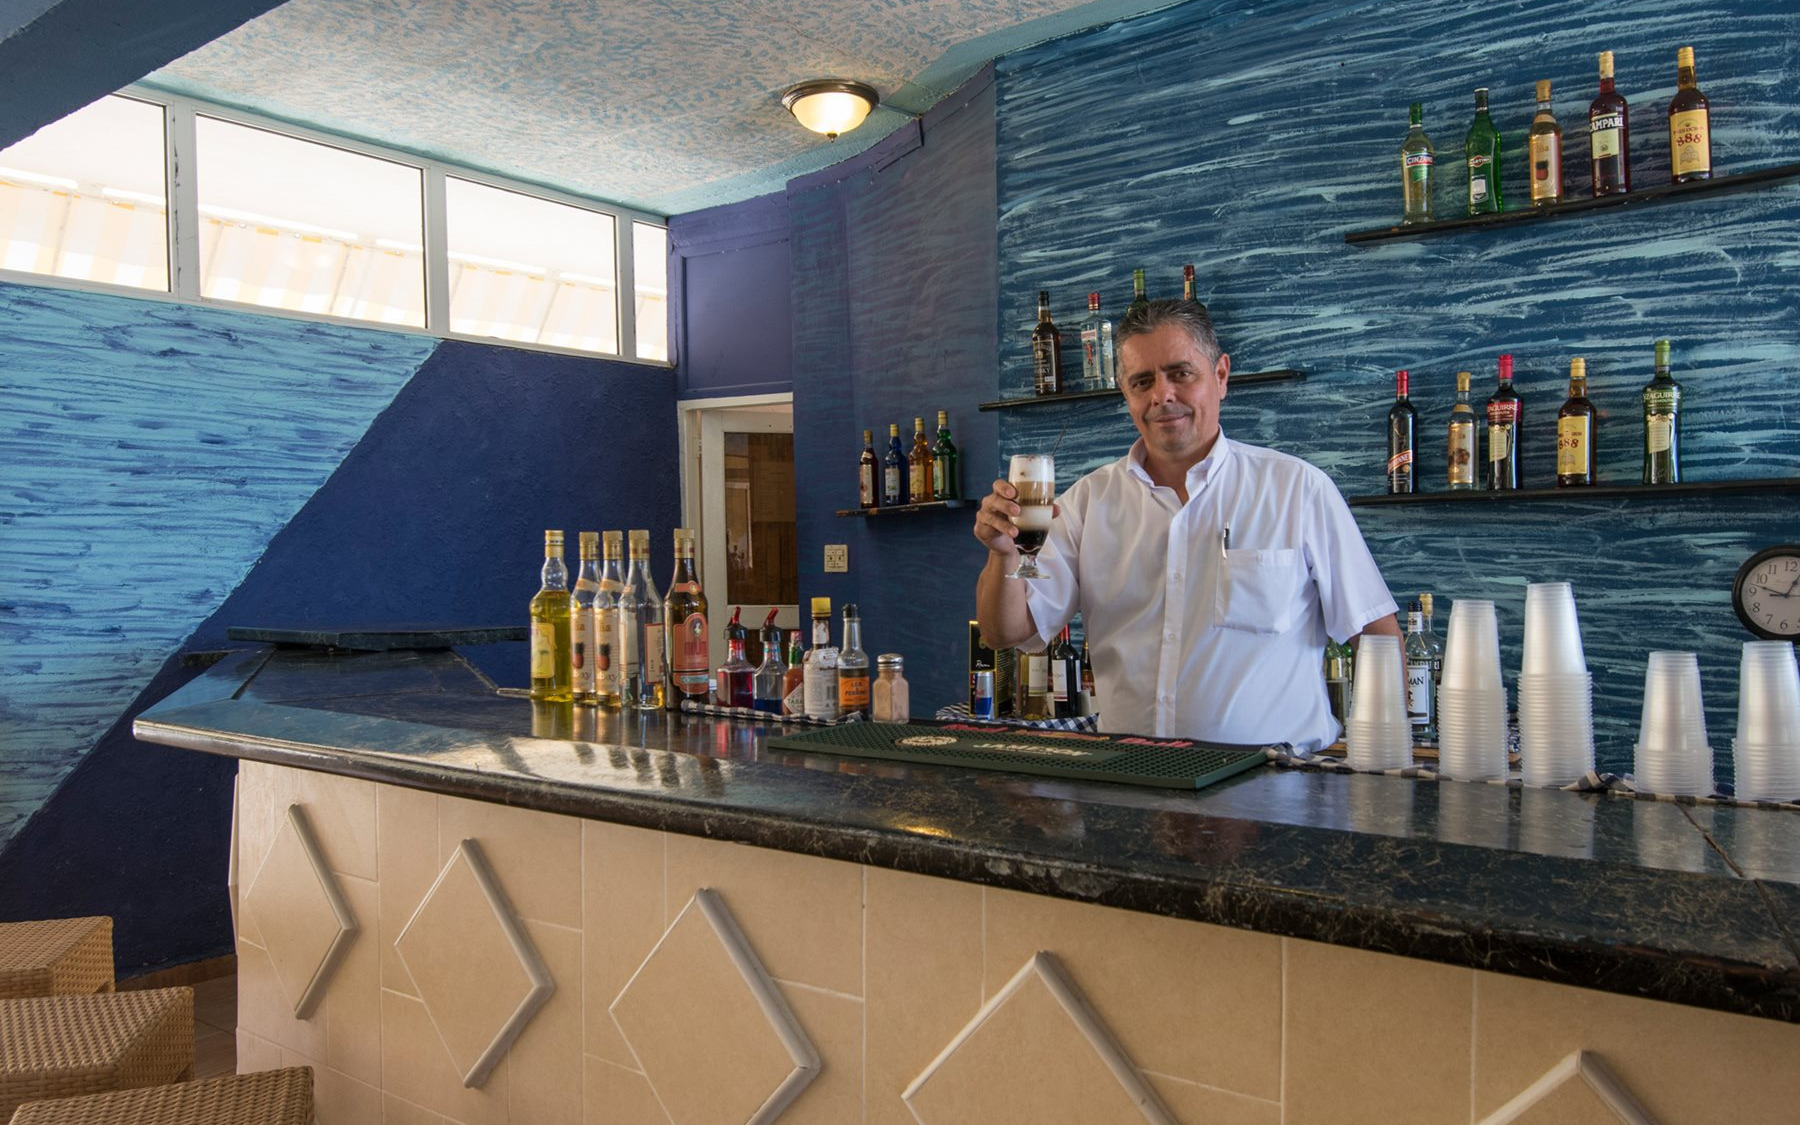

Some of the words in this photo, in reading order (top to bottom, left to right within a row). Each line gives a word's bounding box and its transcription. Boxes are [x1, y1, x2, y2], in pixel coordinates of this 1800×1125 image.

[1677, 133, 1702, 147] 888
[1408, 156, 1433, 164] CINZAN
[1559, 438, 1580, 450] 888
[1768, 565, 1777, 575] 11
[1785, 561, 1798, 572] 12
[1756, 574, 1768, 584] 10
[1749, 587, 1757, 596] 9
[1752, 602, 1760, 613] 8
[1766, 614, 1774, 624] 7
[1780, 620, 1788, 630] 6
